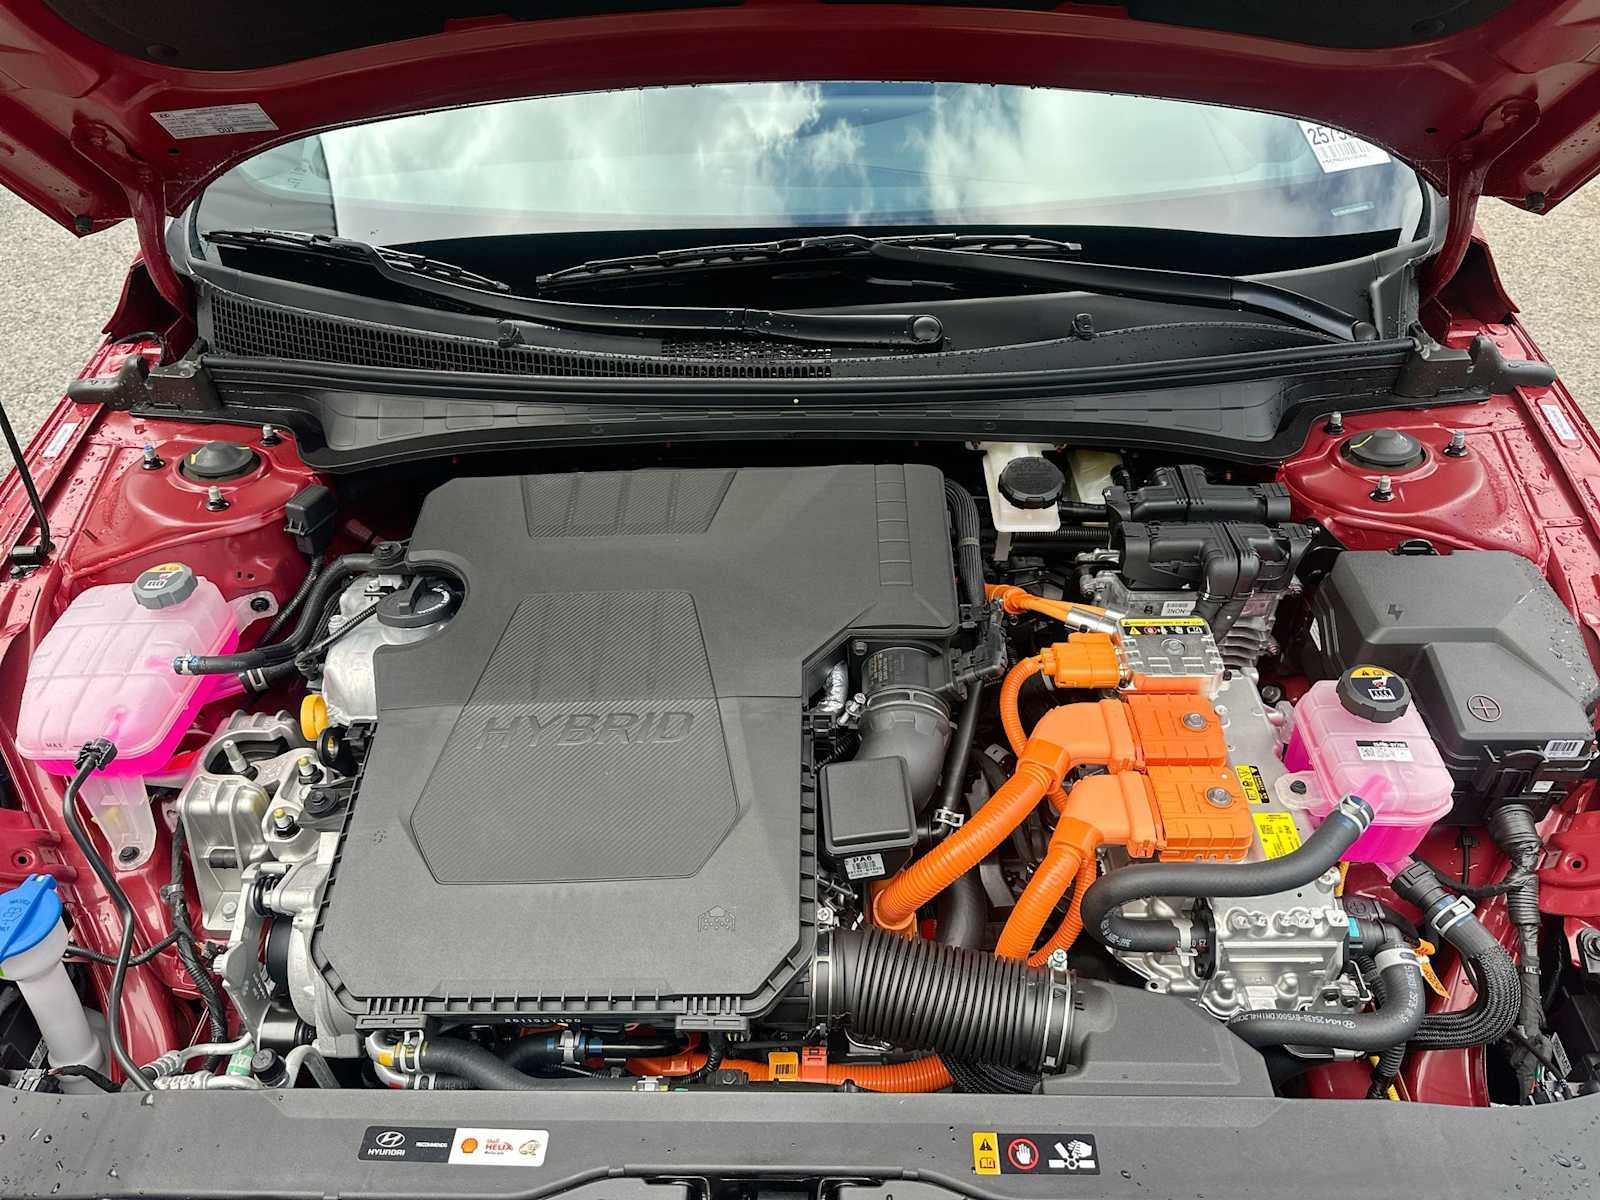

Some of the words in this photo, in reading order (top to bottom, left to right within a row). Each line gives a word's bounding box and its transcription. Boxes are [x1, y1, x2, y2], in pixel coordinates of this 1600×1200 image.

[475, 711, 698, 750] HYBRID
[485, 1142, 514, 1151] HELIX
[367, 1148, 406, 1157] HYUNDAI
